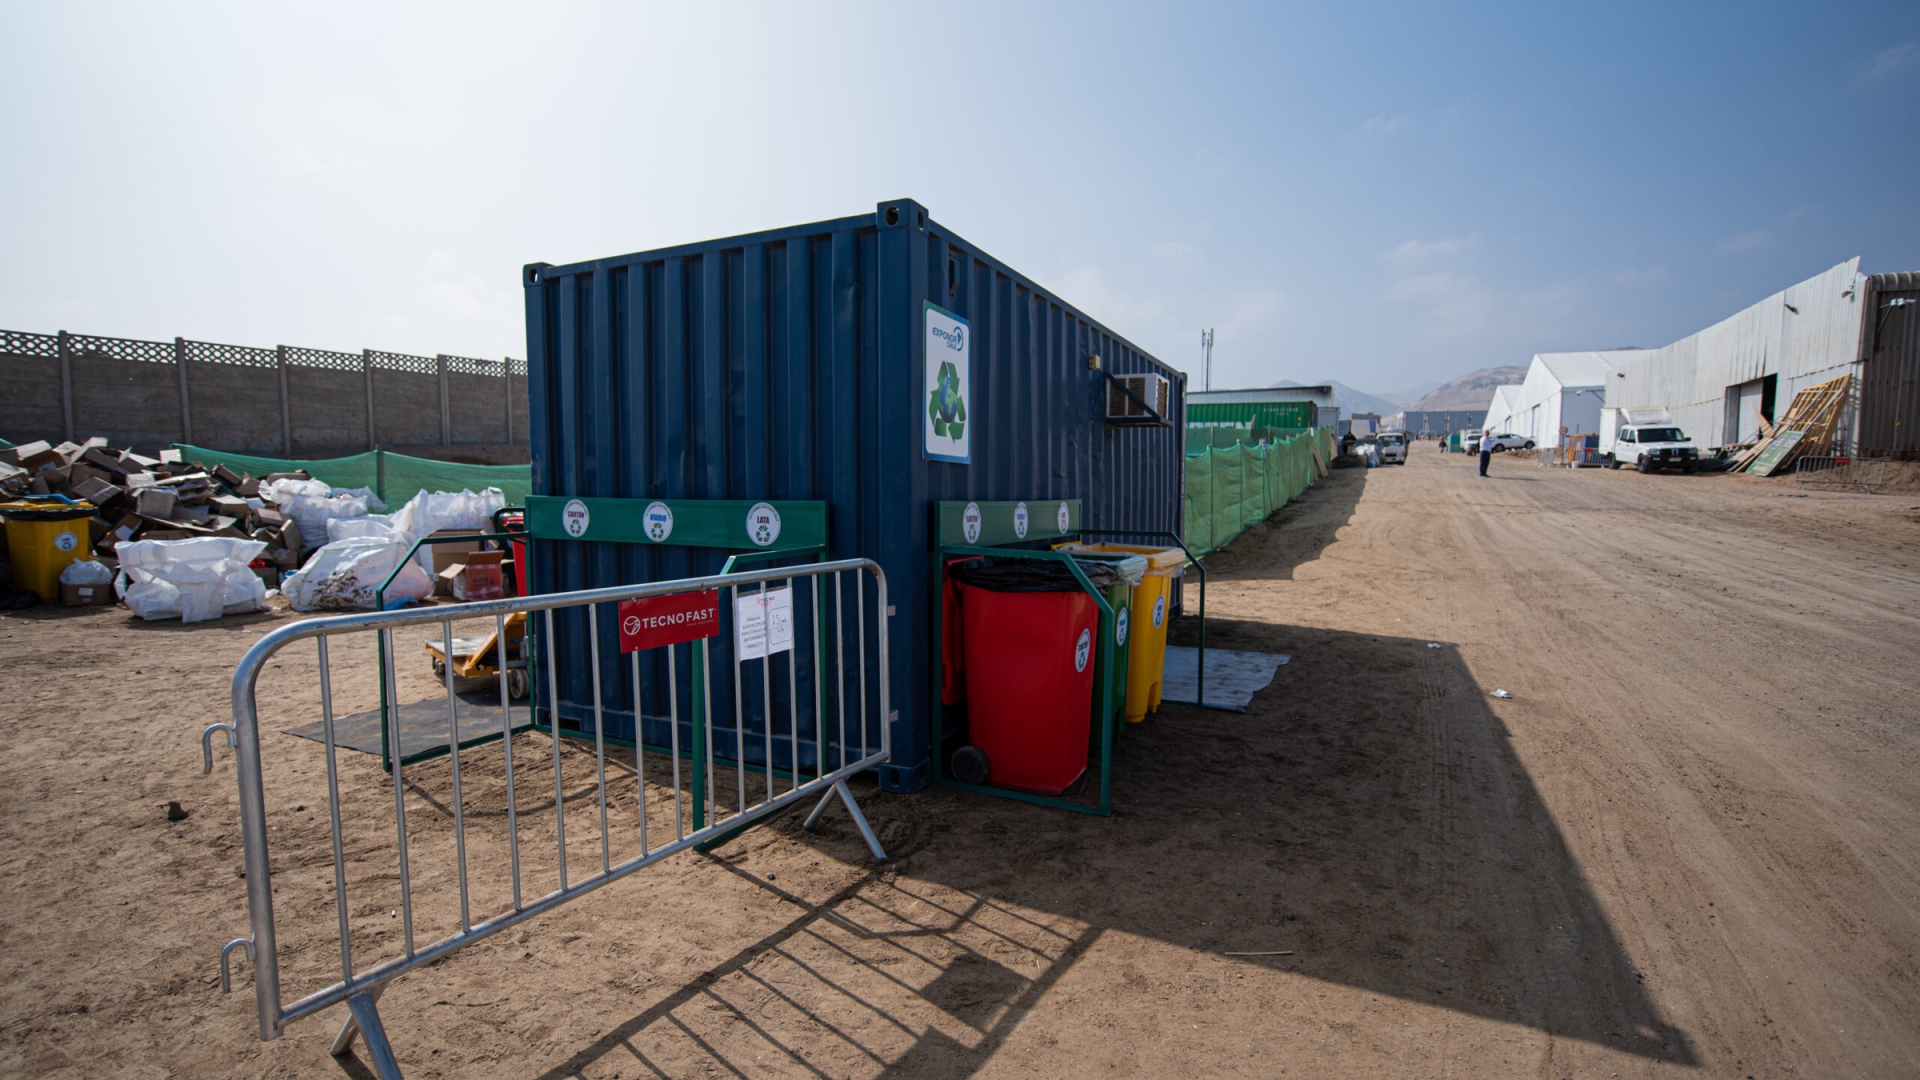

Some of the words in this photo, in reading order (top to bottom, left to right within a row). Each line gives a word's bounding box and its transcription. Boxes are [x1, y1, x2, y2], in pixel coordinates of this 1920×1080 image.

[932, 327, 957, 342] EXPONOR
[946, 341, 957, 351] CHILE
[756, 516, 770, 524] LATA
[641, 608, 714, 629] TECNOFAST
